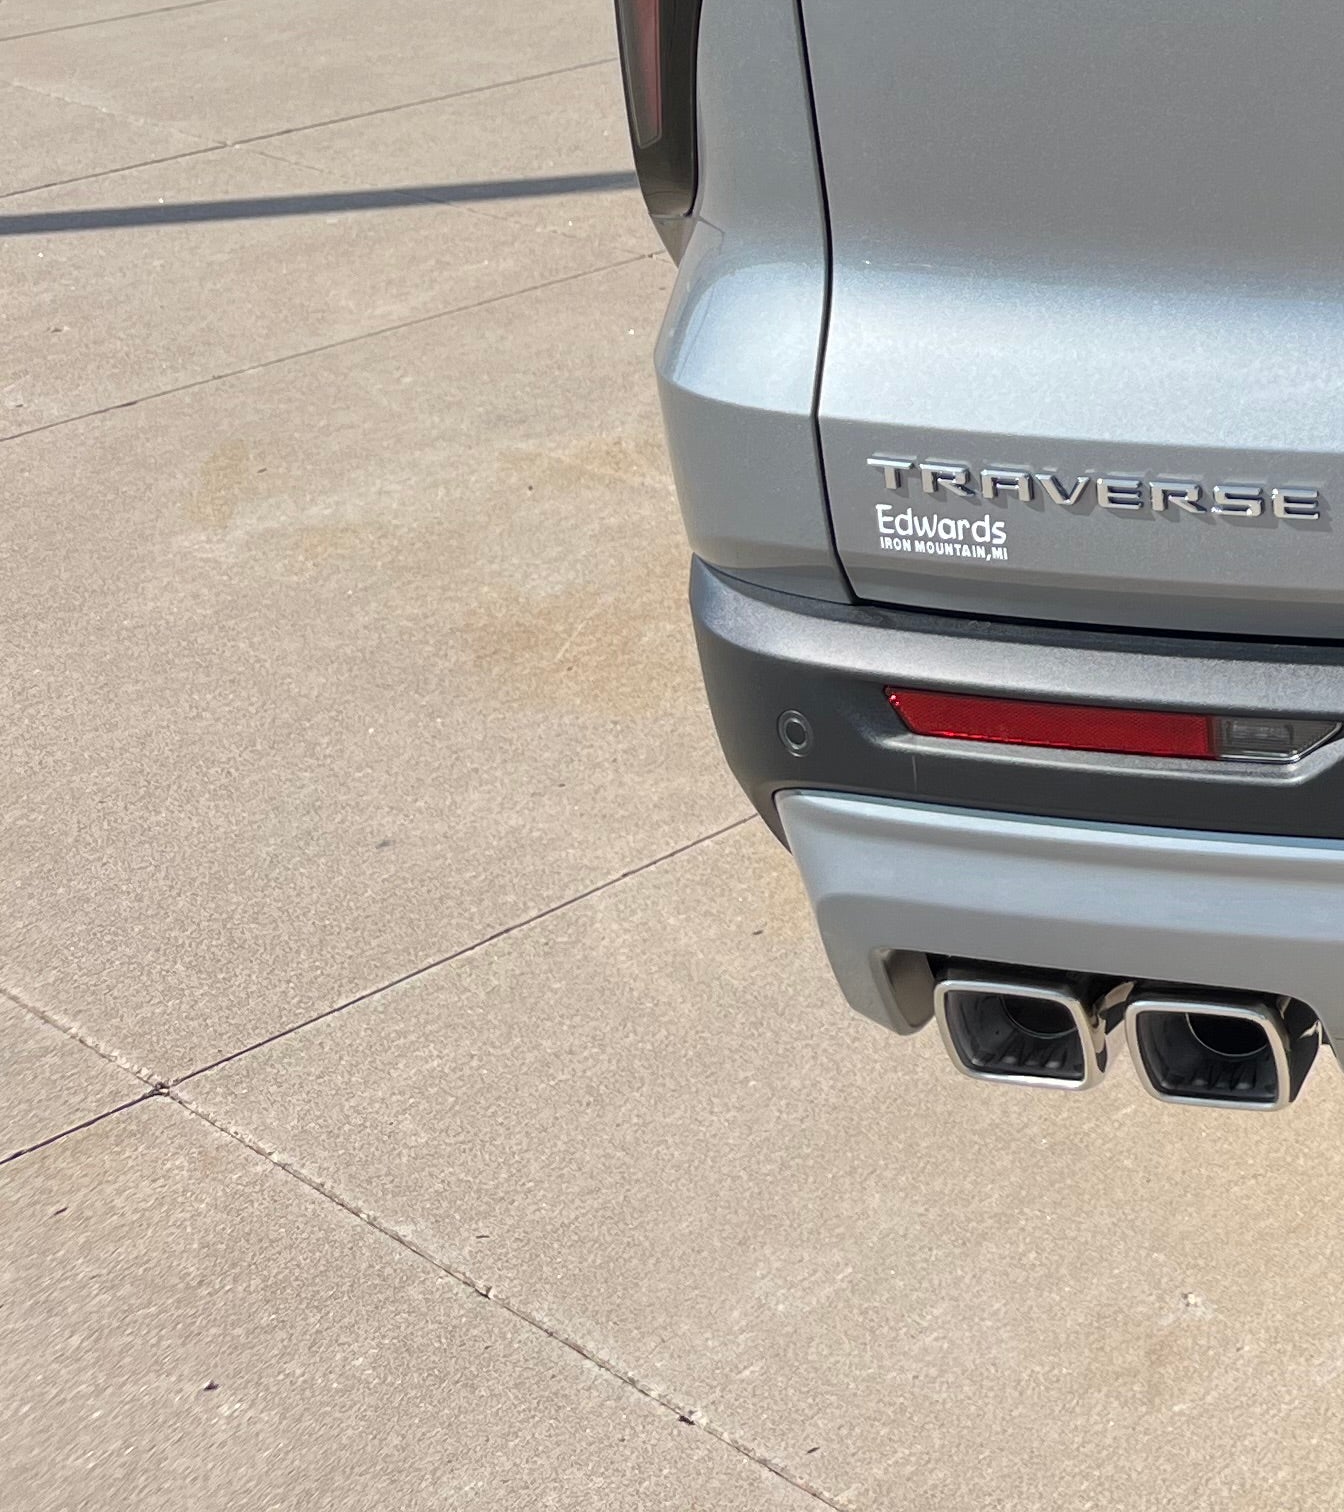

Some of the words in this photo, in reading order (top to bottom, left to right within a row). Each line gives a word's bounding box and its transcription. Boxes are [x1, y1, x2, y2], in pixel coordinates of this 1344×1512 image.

[866, 456, 1319, 520] TRAVERSE
[875, 503, 1007, 545] Edwards
[880, 536, 912, 552] IRON
